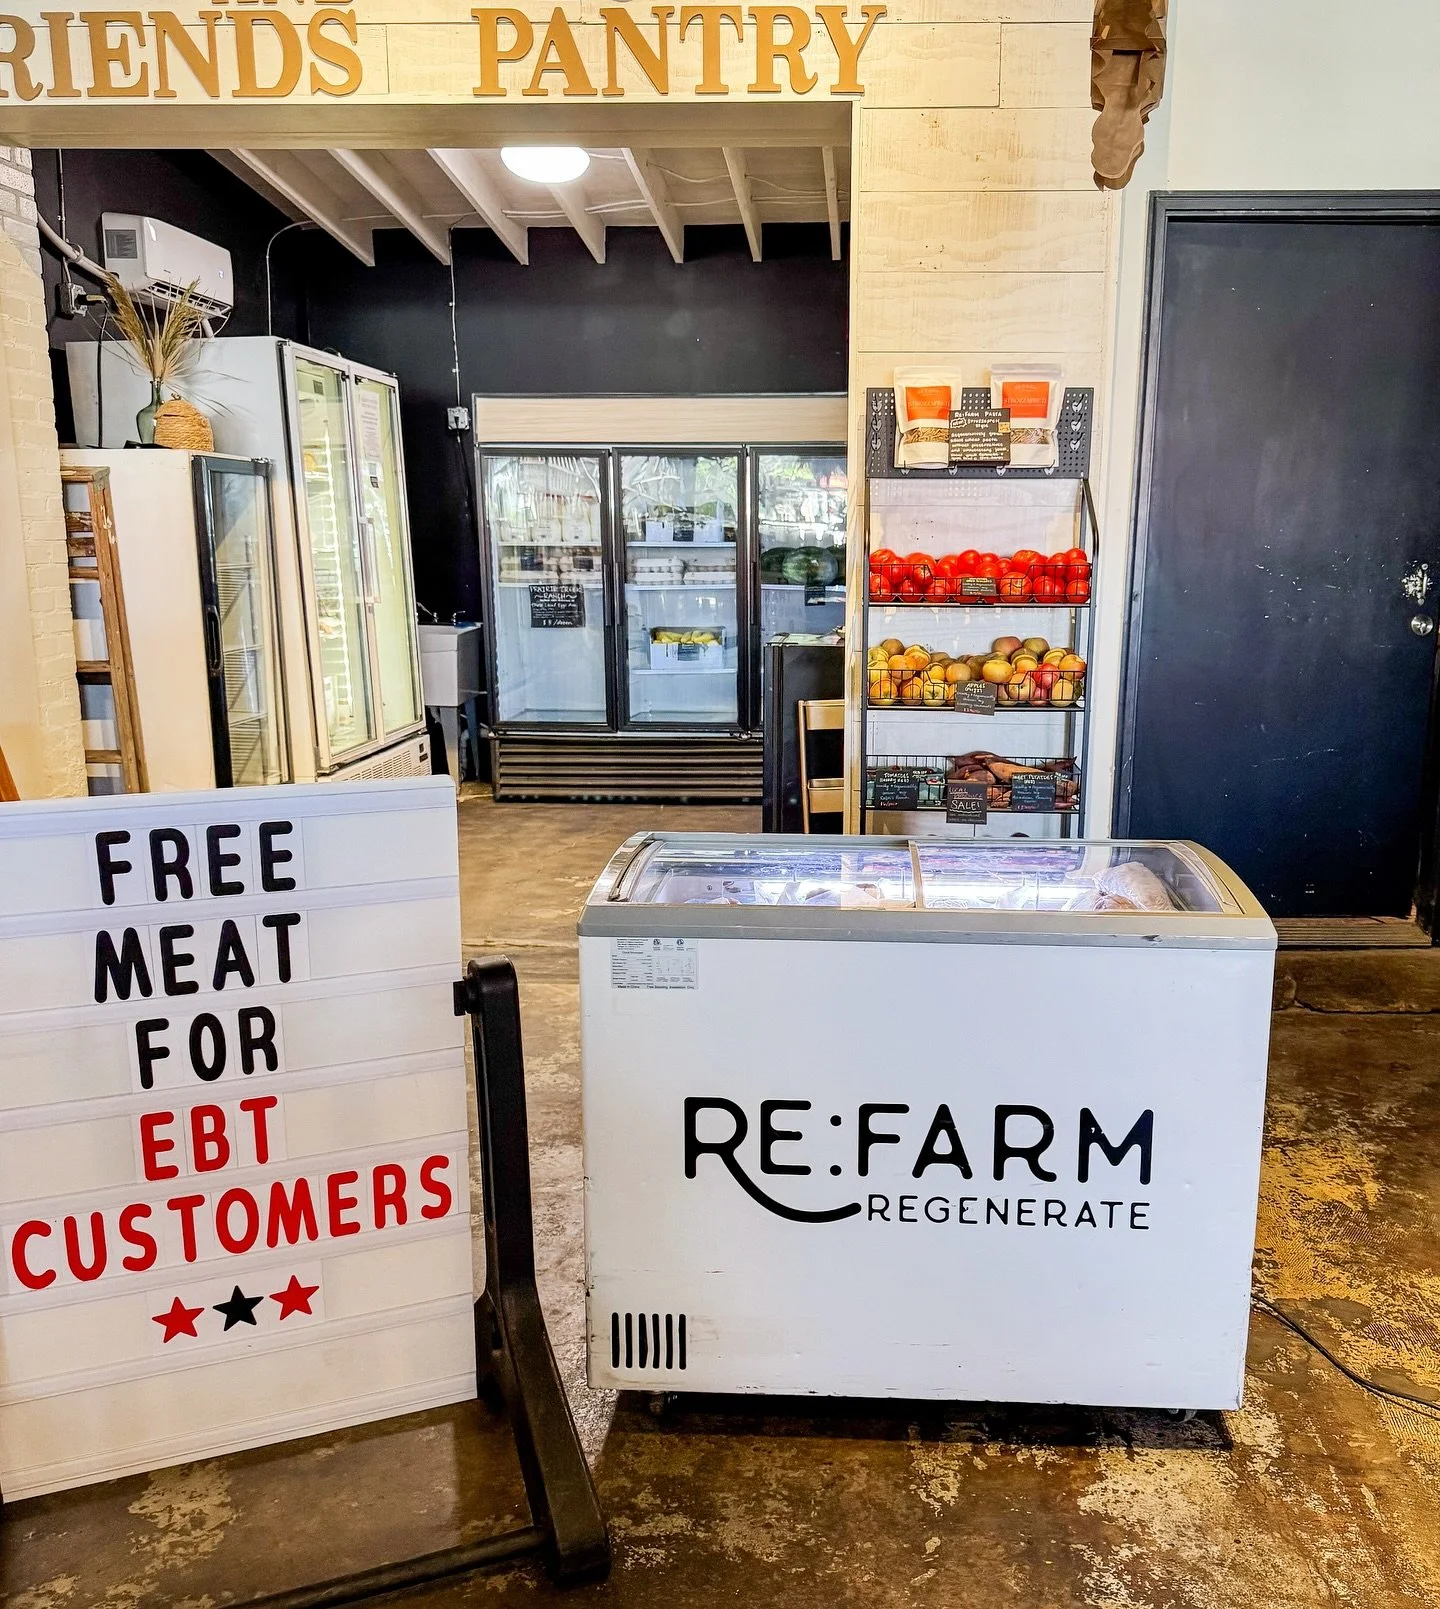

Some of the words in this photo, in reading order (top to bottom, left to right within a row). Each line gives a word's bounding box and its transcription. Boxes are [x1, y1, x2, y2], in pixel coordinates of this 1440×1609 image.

[471, 6, 888, 97] PANTRY
[951, 800, 980, 811] SALE!
[95, 820, 297, 906] FREE
[94, 912, 301, 1004] MEAT
[135, 1005, 279, 1090] FOR
[140, 1095, 279, 1182] EBT
[684, 1097, 1154, 1224] RE:FARM
[11, 1154, 453, 1290] CUSTOMERS
[867, 1194, 1151, 1230] REGENERATE
